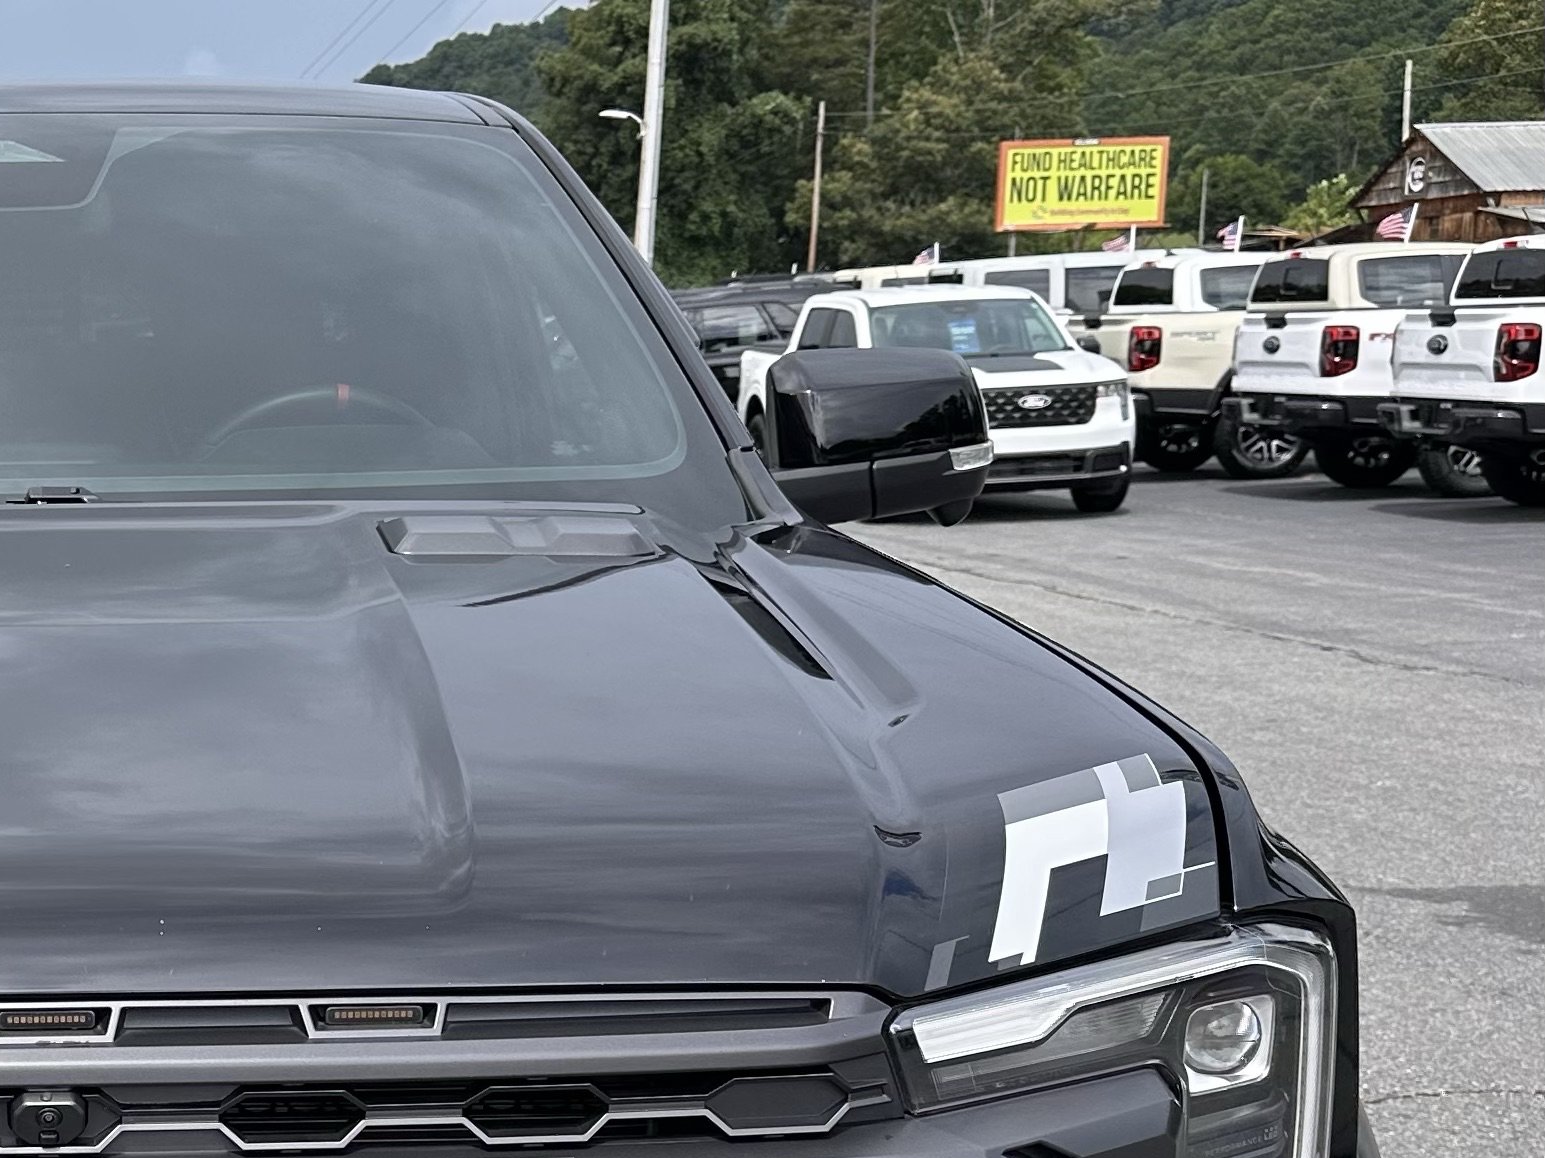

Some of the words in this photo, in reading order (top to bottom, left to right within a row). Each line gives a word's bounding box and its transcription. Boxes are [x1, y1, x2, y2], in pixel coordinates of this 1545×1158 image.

[1011, 152, 1052, 172] FUND
[1057, 149, 1157, 171] HEALTHCARE
[1010, 176, 1051, 203] NOT
[1057, 173, 1157, 202] WARFARE
